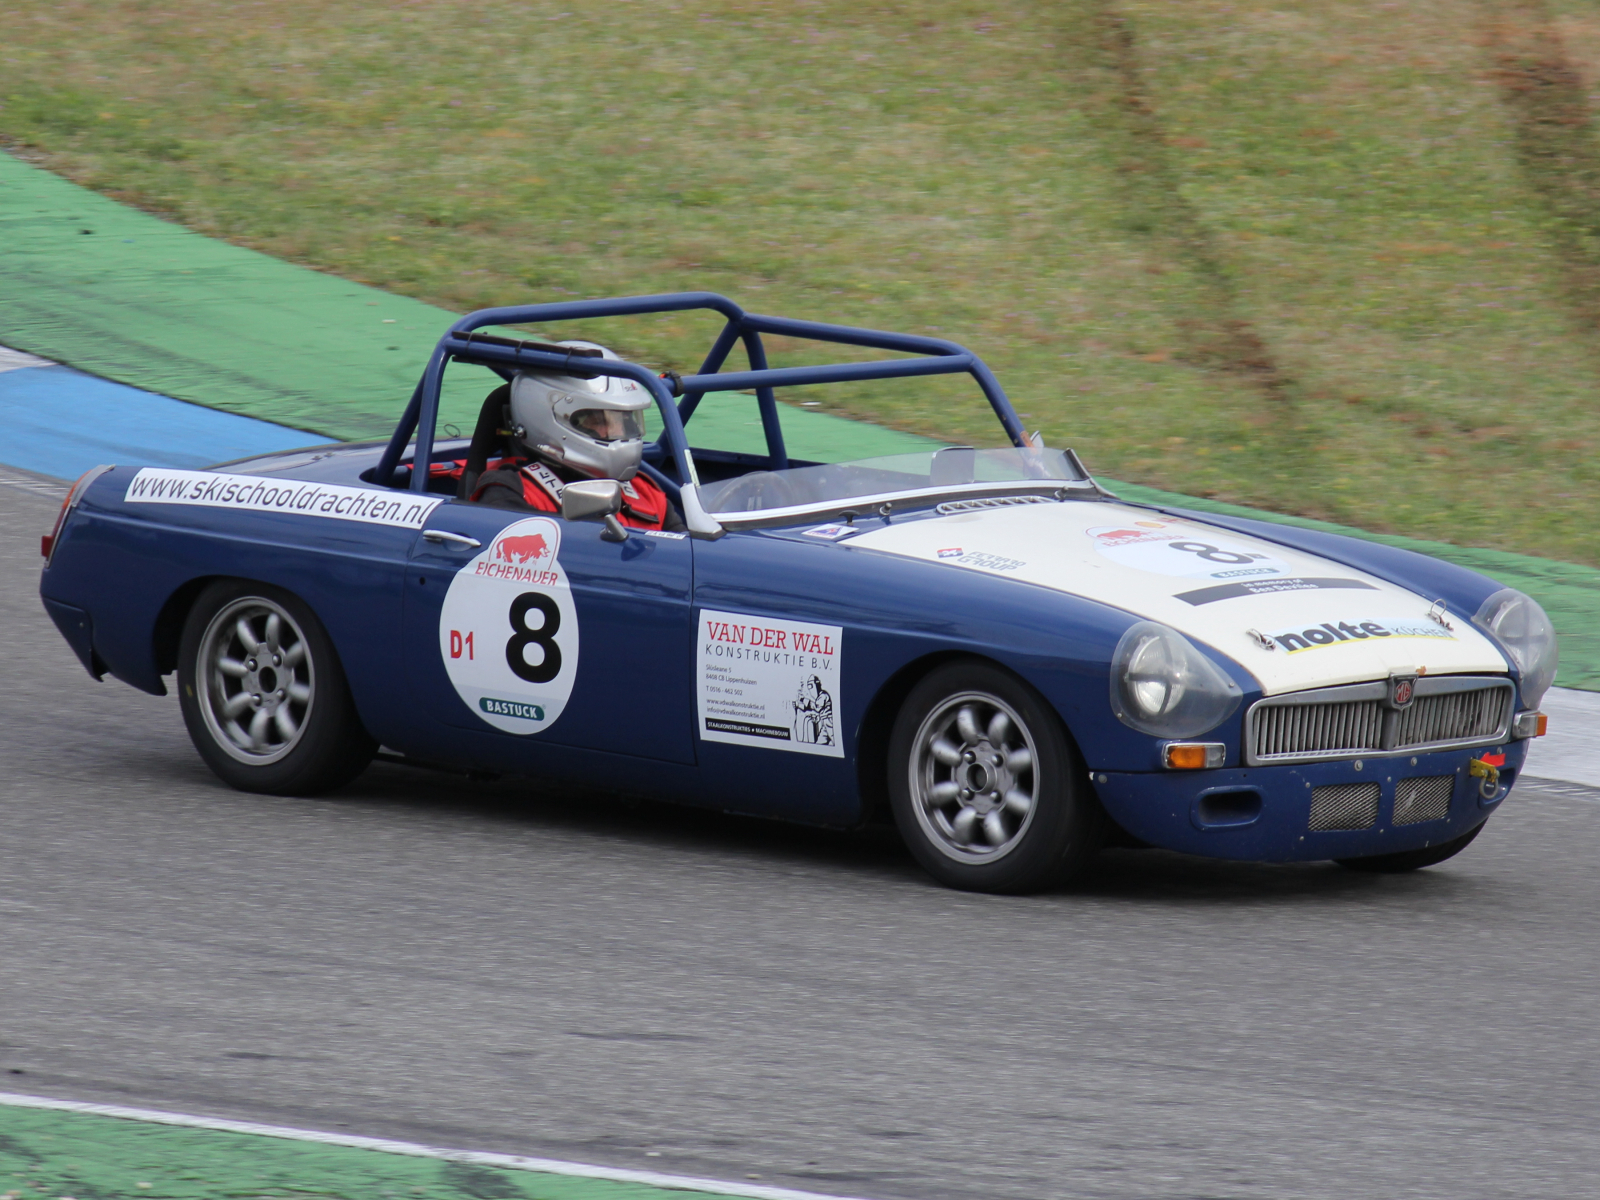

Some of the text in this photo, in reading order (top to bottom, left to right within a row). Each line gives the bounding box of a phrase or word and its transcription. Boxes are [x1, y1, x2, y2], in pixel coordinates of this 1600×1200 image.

[131, 476, 434, 524] www.skischooldrachten.nl
[957, 555, 1017, 571] GROUP
[1168, 541, 1254, 564] 8
[475, 562, 558, 586] EICHENAUER
[450, 630, 474, 660] D1
[505, 592, 562, 684] 8
[706, 621, 834, 655] VAN DER WAL
[1274, 621, 1392, 652] nolte
[705, 644, 833, 671] KONSTRUKTIE B.V.
[1395, 681, 1410, 701] MG
[486, 700, 538, 719] BASTUCK
